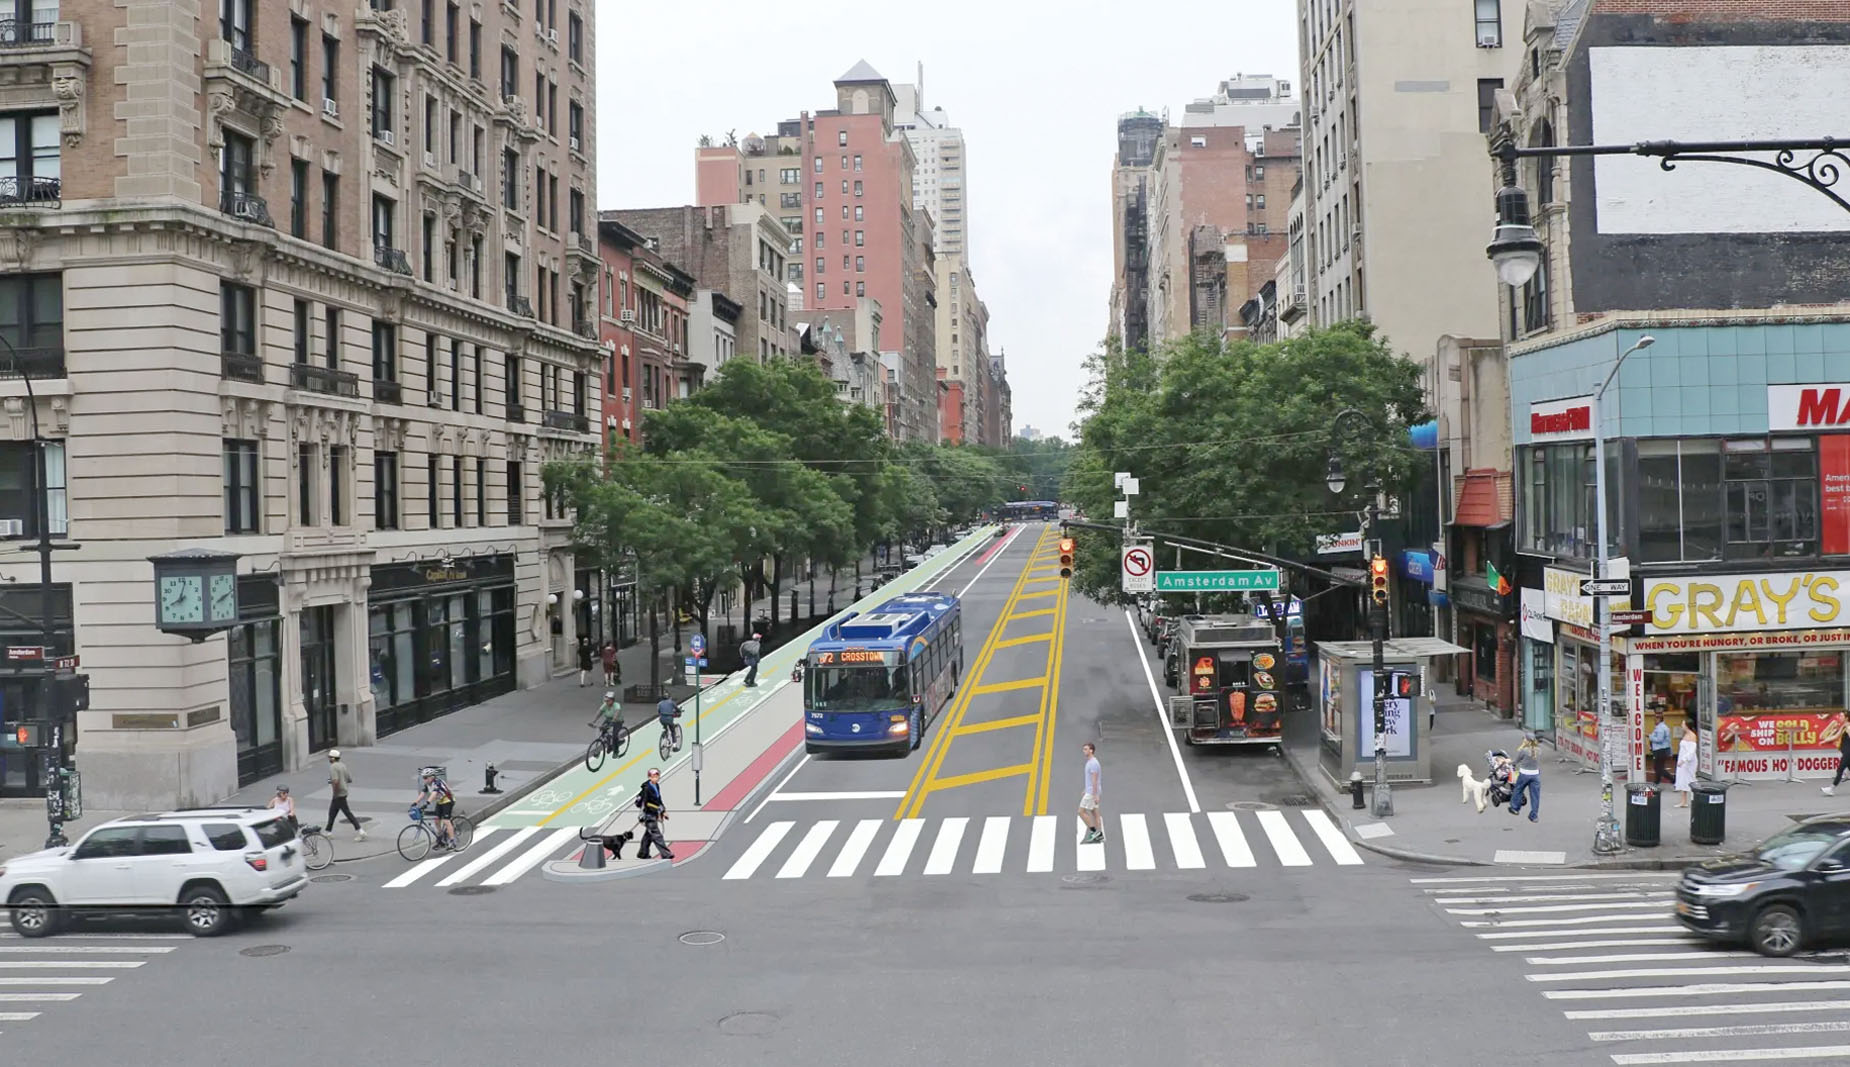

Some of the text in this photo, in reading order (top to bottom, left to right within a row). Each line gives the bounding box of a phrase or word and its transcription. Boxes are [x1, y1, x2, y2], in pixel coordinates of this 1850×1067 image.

[1329, 538, 1360, 548] UNKIN'
[1163, 575, 1273, 586] Amsterdam Av
[1610, 583, 1626, 591] WAY
[1646, 573, 1841, 629] GRAY'S
[1634, 641, 1664, 650] WHEN
[1666, 639, 1701, 648] YOU'RE
[1703, 638, 1747, 647] HUNGRY,
[1750, 636, 1763, 645] OR
[1766, 635, 1801, 644] BROKE,
[1803, 634, 1817, 642] OR
[1819, 633, 1841, 642] JUST
[1633, 669, 1642, 771] WELCOME
[1758, 720, 1775, 729] WE
[1750, 729, 1775, 738] SHIP
[1758, 737, 1774, 746] ON
[1772, 759, 1794, 772] HO
